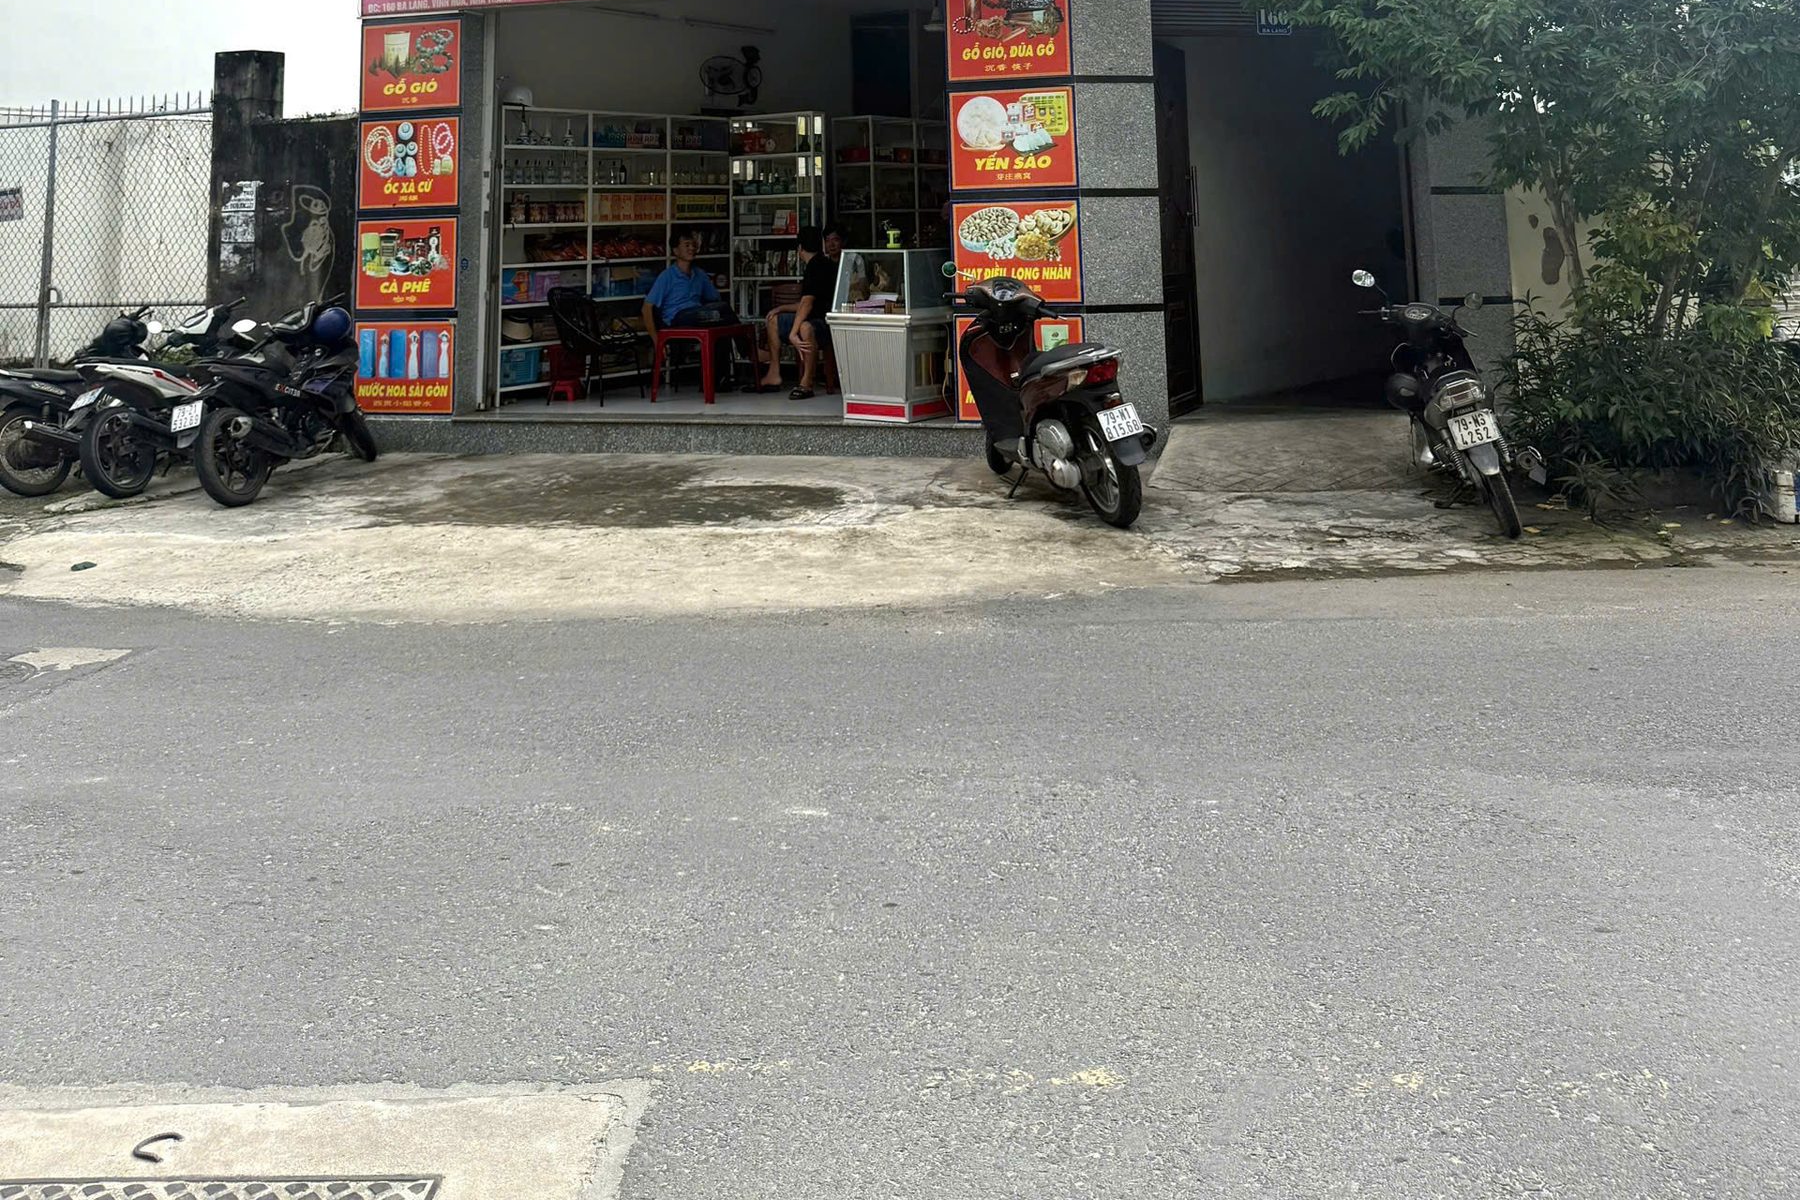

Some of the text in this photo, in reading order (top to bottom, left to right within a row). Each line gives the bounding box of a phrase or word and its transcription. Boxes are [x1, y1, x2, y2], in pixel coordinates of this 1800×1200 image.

[397, 1, 407, 11] BA
[962, 42, 980, 60] GỖ
[1010, 42, 1034, 58] ĐŨA
[1036, 37, 1055, 56] GỖ
[383, 77, 438, 95] GỖ GIÓ
[975, 152, 1052, 171] YẾN SÀO
[384, 177, 399, 194] ỐC
[400, 179, 415, 193] XÀ
[1011, 267, 1040, 280] LONG
[380, 278, 431, 293] CÀ PHÊ
[358, 382, 448, 397] NƯỚC HOA SÀI GÒN
[1105, 419, 1140, 440] 815.68
[1460, 426, 1492, 445] 4252
